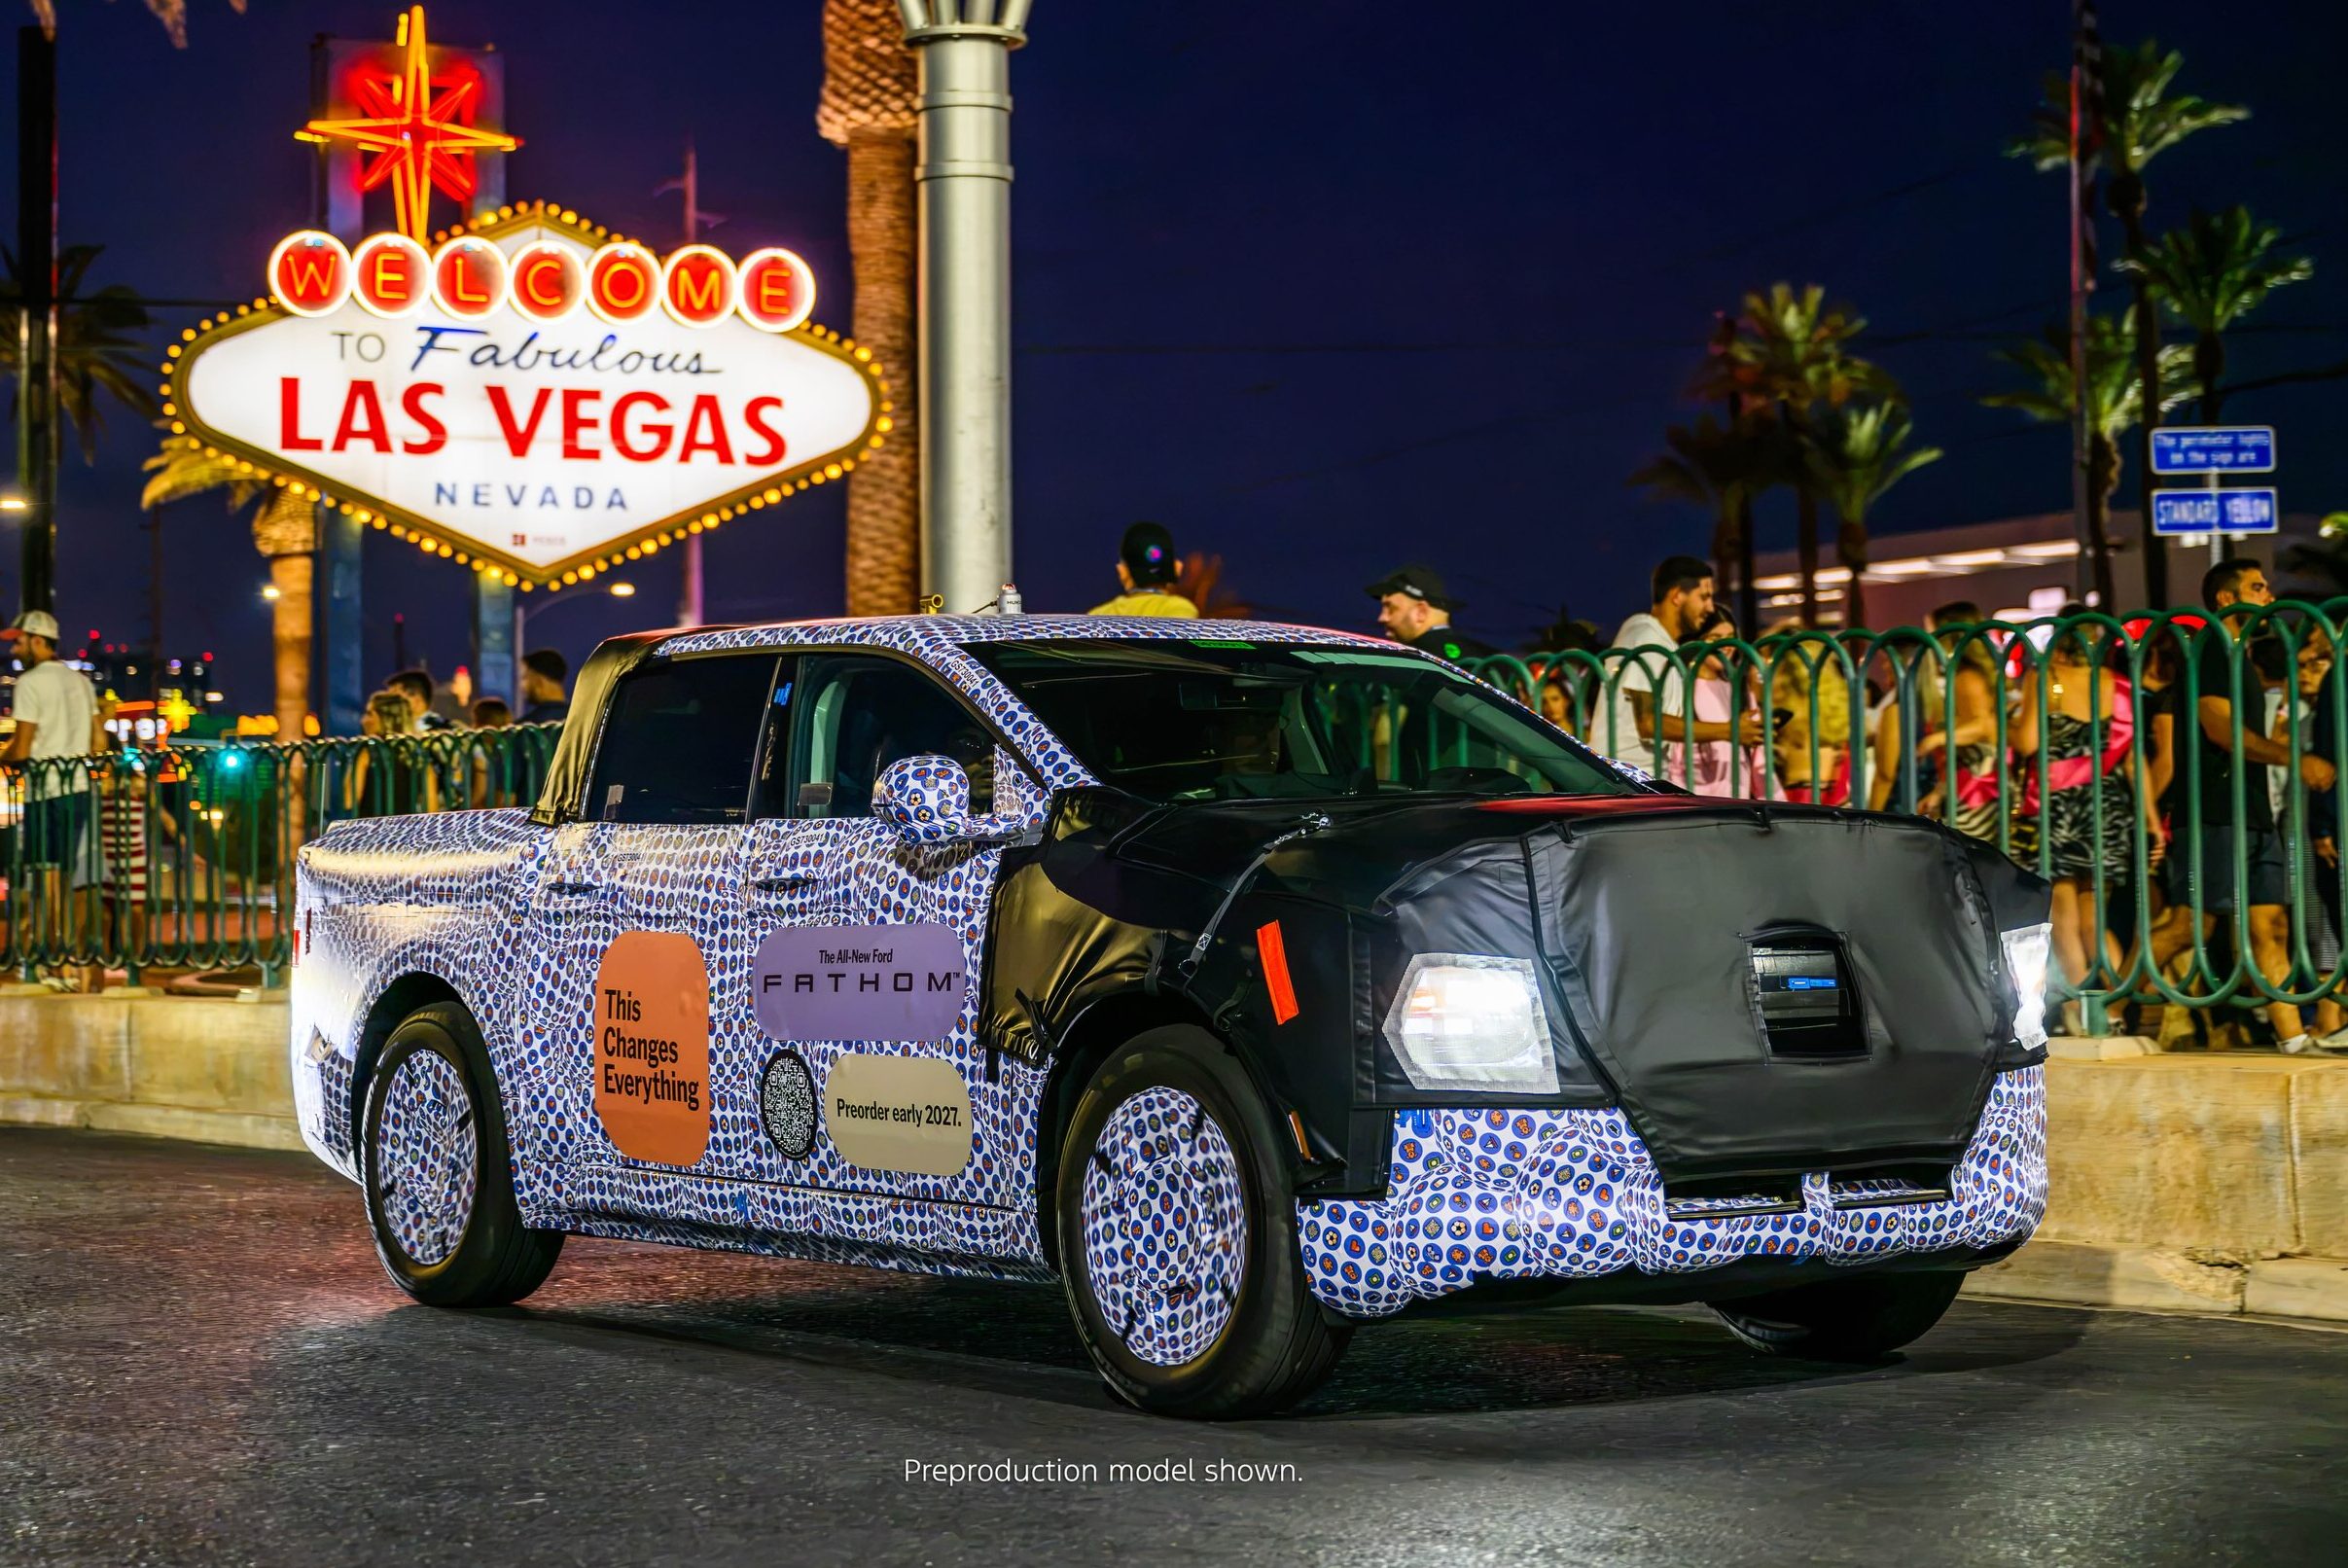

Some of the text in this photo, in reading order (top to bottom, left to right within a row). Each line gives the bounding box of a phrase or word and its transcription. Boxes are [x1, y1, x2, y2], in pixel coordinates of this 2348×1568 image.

[286, 251, 792, 315] WELCOME
[331, 326, 725, 375] TO Fabulous
[279, 376, 788, 469] LAS VEGAS
[435, 481, 628, 512] NEVADA
[2157, 500, 2219, 525] STANDARD
[951, 660, 979, 687] GS730041
[791, 833, 824, 846] GS730041
[819, 948, 894, 964] The All-New Ford
[604, 988, 641, 1022] This
[604, 1026, 679, 1069] Changes
[604, 1063, 699, 1111] Everything
[836, 1098, 962, 1127] Preorder early 2027.
